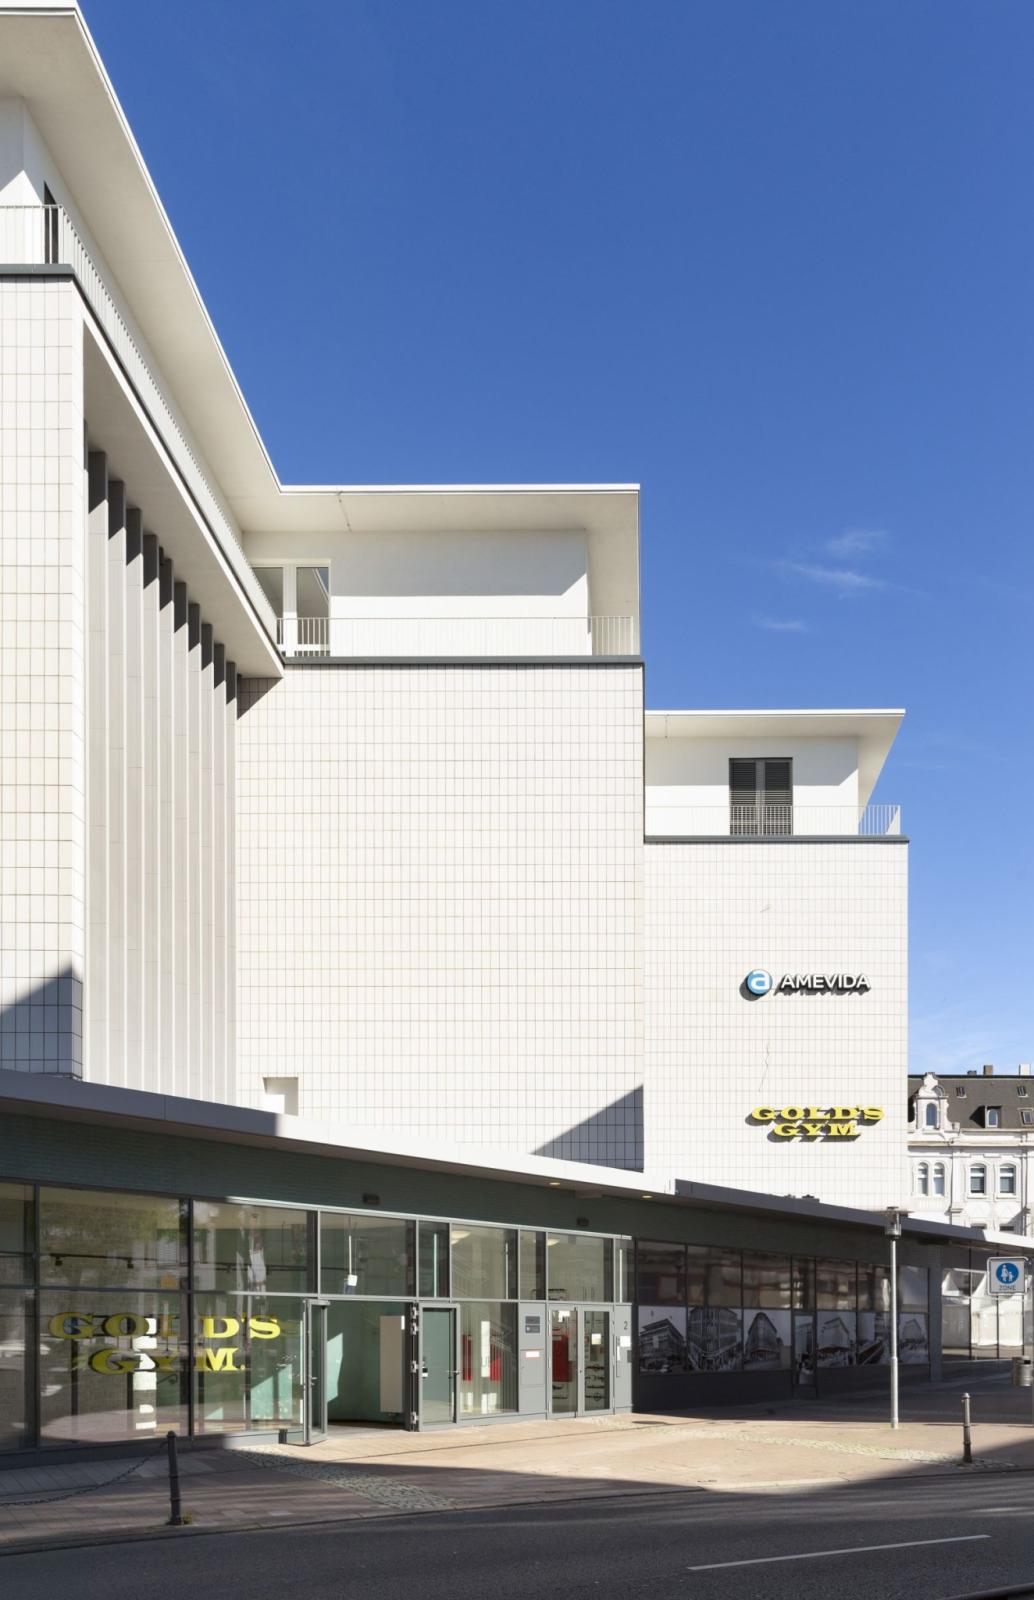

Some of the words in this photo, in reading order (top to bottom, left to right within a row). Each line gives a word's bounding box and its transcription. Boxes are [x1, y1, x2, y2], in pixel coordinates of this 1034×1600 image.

[780, 974, 871, 989] AMEVIDA
[751, 1105, 884, 1120] GOLD'S
[774, 1123, 856, 1136] GYM
[623, 1320, 629, 1330] 2
